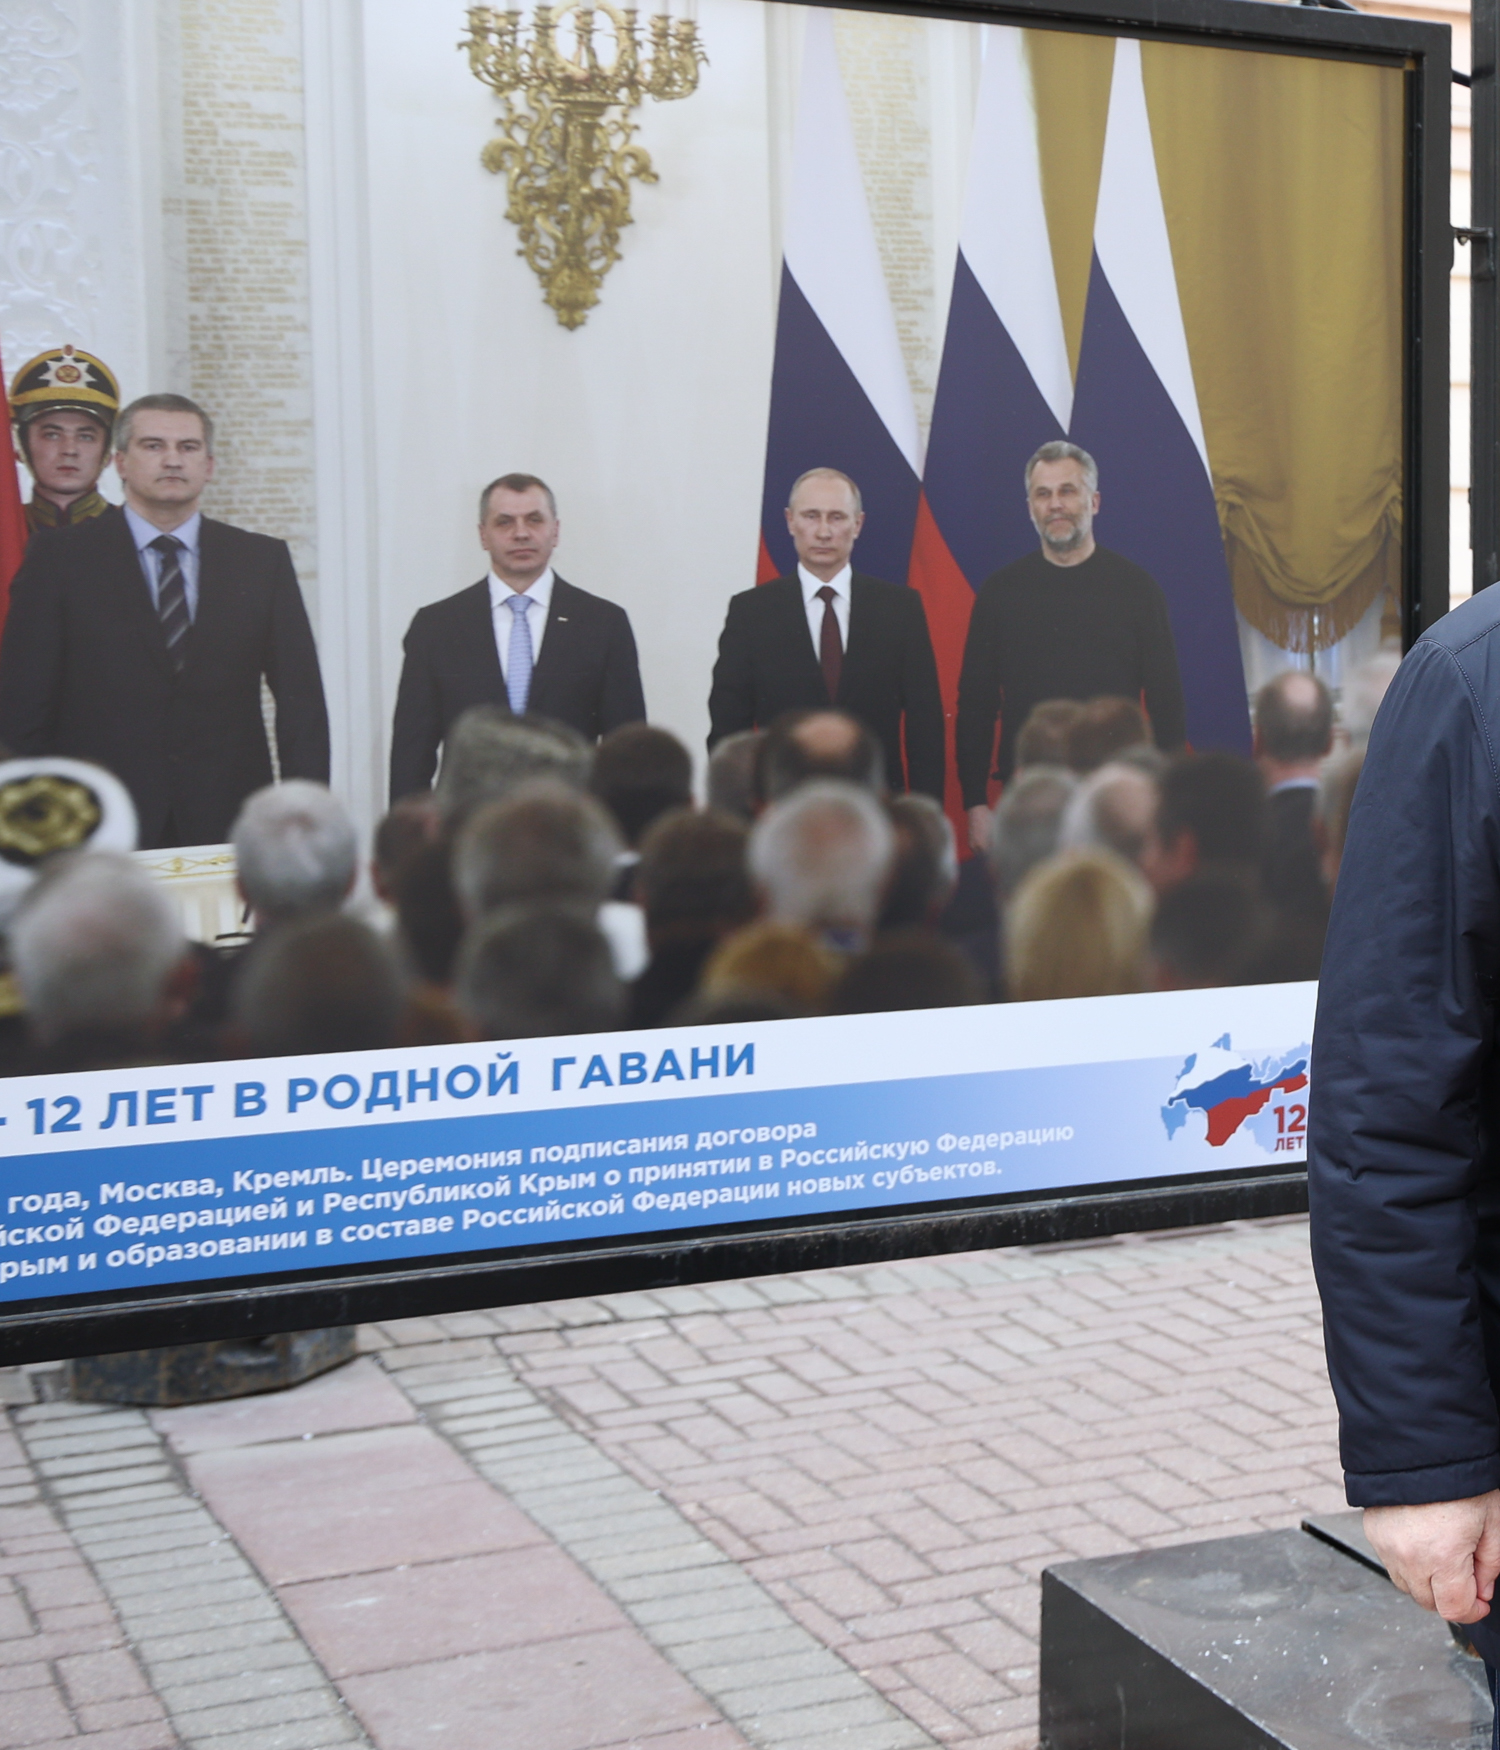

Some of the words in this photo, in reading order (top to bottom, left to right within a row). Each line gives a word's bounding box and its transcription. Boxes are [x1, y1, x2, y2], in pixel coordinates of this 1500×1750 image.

[26, 1095, 82, 1135] 12
[98, 1084, 215, 1130] ЛЕТ
[234, 1081, 268, 1118] В
[287, 1051, 520, 1114] РОДНОЙ
[551, 1042, 756, 1092] ГАВАНИ
[1273, 1103, 1306, 1134] 12
[8, 1190, 90, 1214] года,
[99, 1177, 224, 1206] Москва,
[232, 1165, 353, 1194] Кремль.
[361, 1147, 522, 1181] Церемония
[529, 1133, 689, 1164] подписания
[694, 1121, 818, 1151] договора
[93, 1195, 288, 1238] Федерацией
[296, 1198, 314, 1218] и
[323, 1176, 512, 1215] Республикой
[519, 1171, 597, 1196] Крым
[603, 1168, 622, 1186] о
[628, 1155, 751, 1186] принятии
[758, 1154, 774, 1171] в
[781, 1137, 931, 1168] Российскую
[936, 1125, 1075, 1154] Федерацию
[1274, 1135, 1305, 1152] ЛЕТ
[77, 1252, 97, 1271] и
[106, 1229, 308, 1268] образовании
[315, 1227, 333, 1246] в
[340, 1214, 455, 1243] составе
[462, 1193, 625, 1230] Российской
[632, 1180, 780, 1212] Федерации
[786, 1175, 865, 1197] новых
[872, 1160, 1003, 1189] субъектов.
